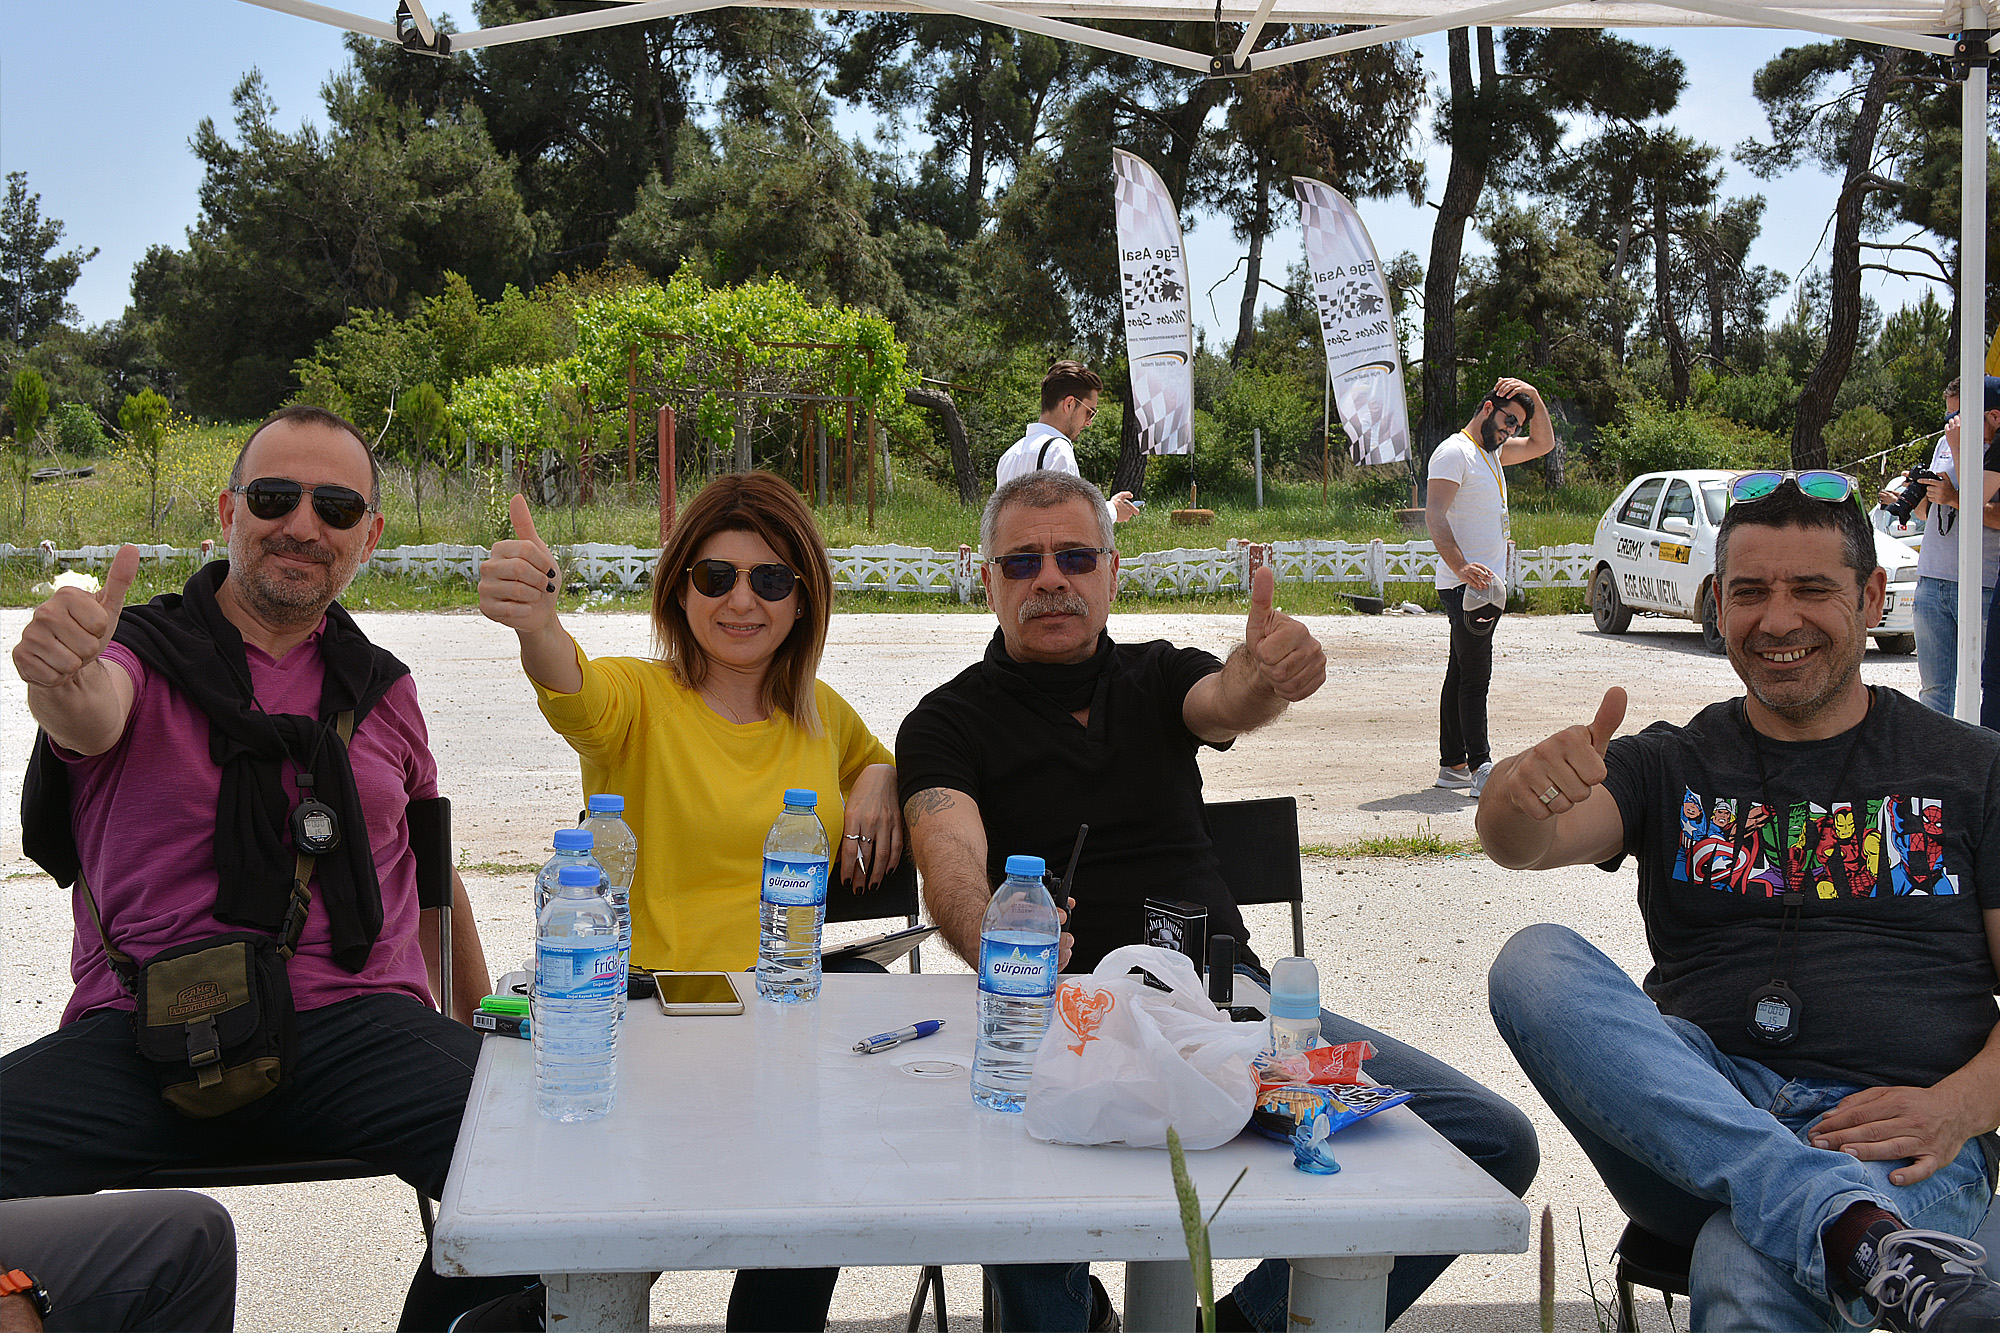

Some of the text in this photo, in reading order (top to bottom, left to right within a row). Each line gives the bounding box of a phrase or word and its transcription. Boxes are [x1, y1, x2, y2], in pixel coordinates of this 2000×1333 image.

[1624, 574, 1682, 606] EGE ASAL METAL
[1671, 786, 1959, 899] MARVEL
[768, 876, 811, 889] gürpınar
[1149, 918, 1163, 932] JACK
[994, 962, 1043, 976] gürpınar
